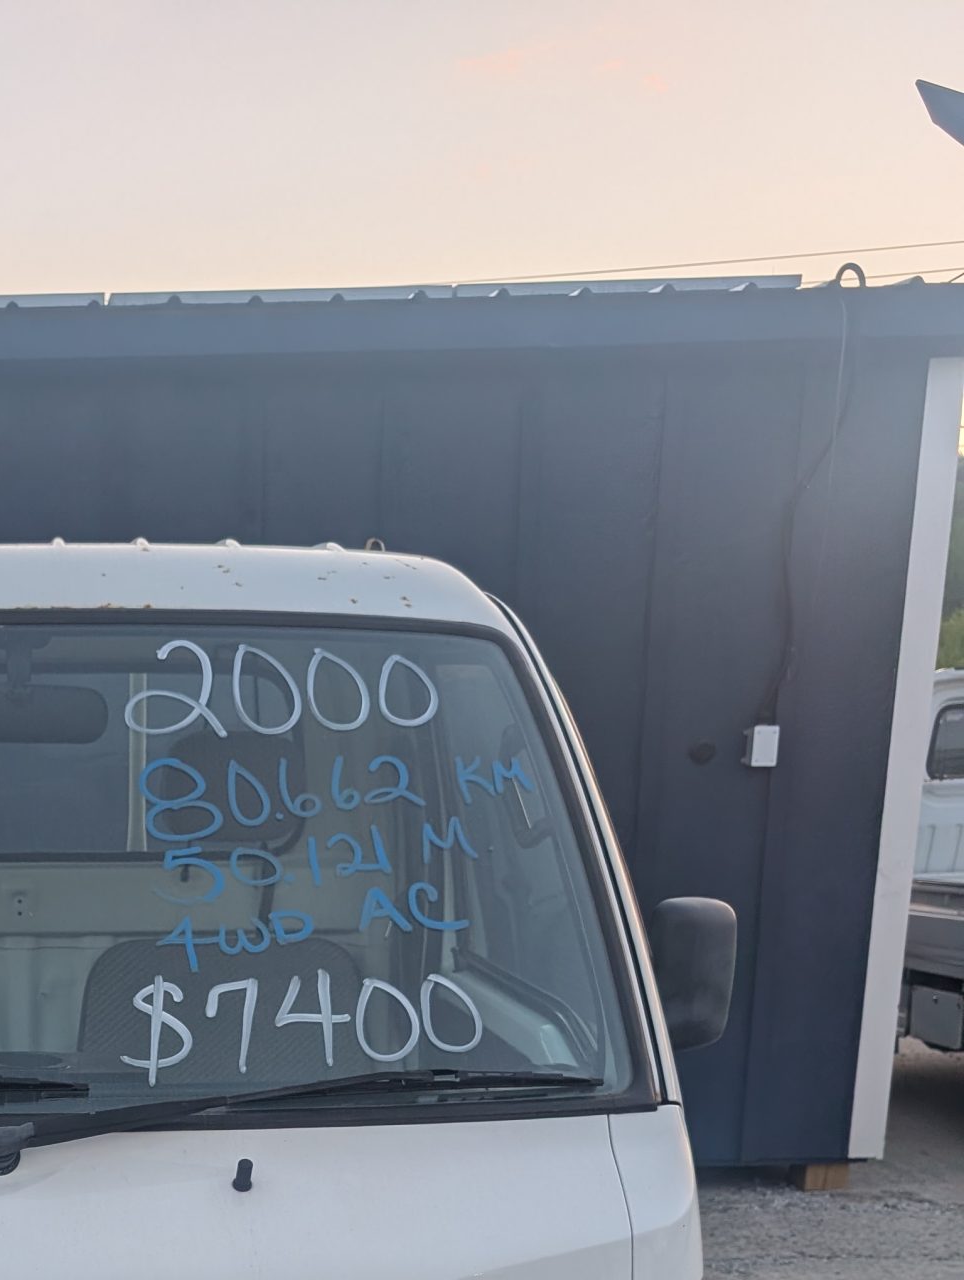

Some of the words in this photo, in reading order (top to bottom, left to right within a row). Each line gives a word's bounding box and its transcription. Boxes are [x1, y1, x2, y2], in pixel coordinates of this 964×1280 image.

[125, 640, 438, 737] 2000
[454, 756, 534, 803] KM
[423, 816, 478, 863] M
[359, 882, 469, 932] AC
[120, 968, 482, 1087] $7400
